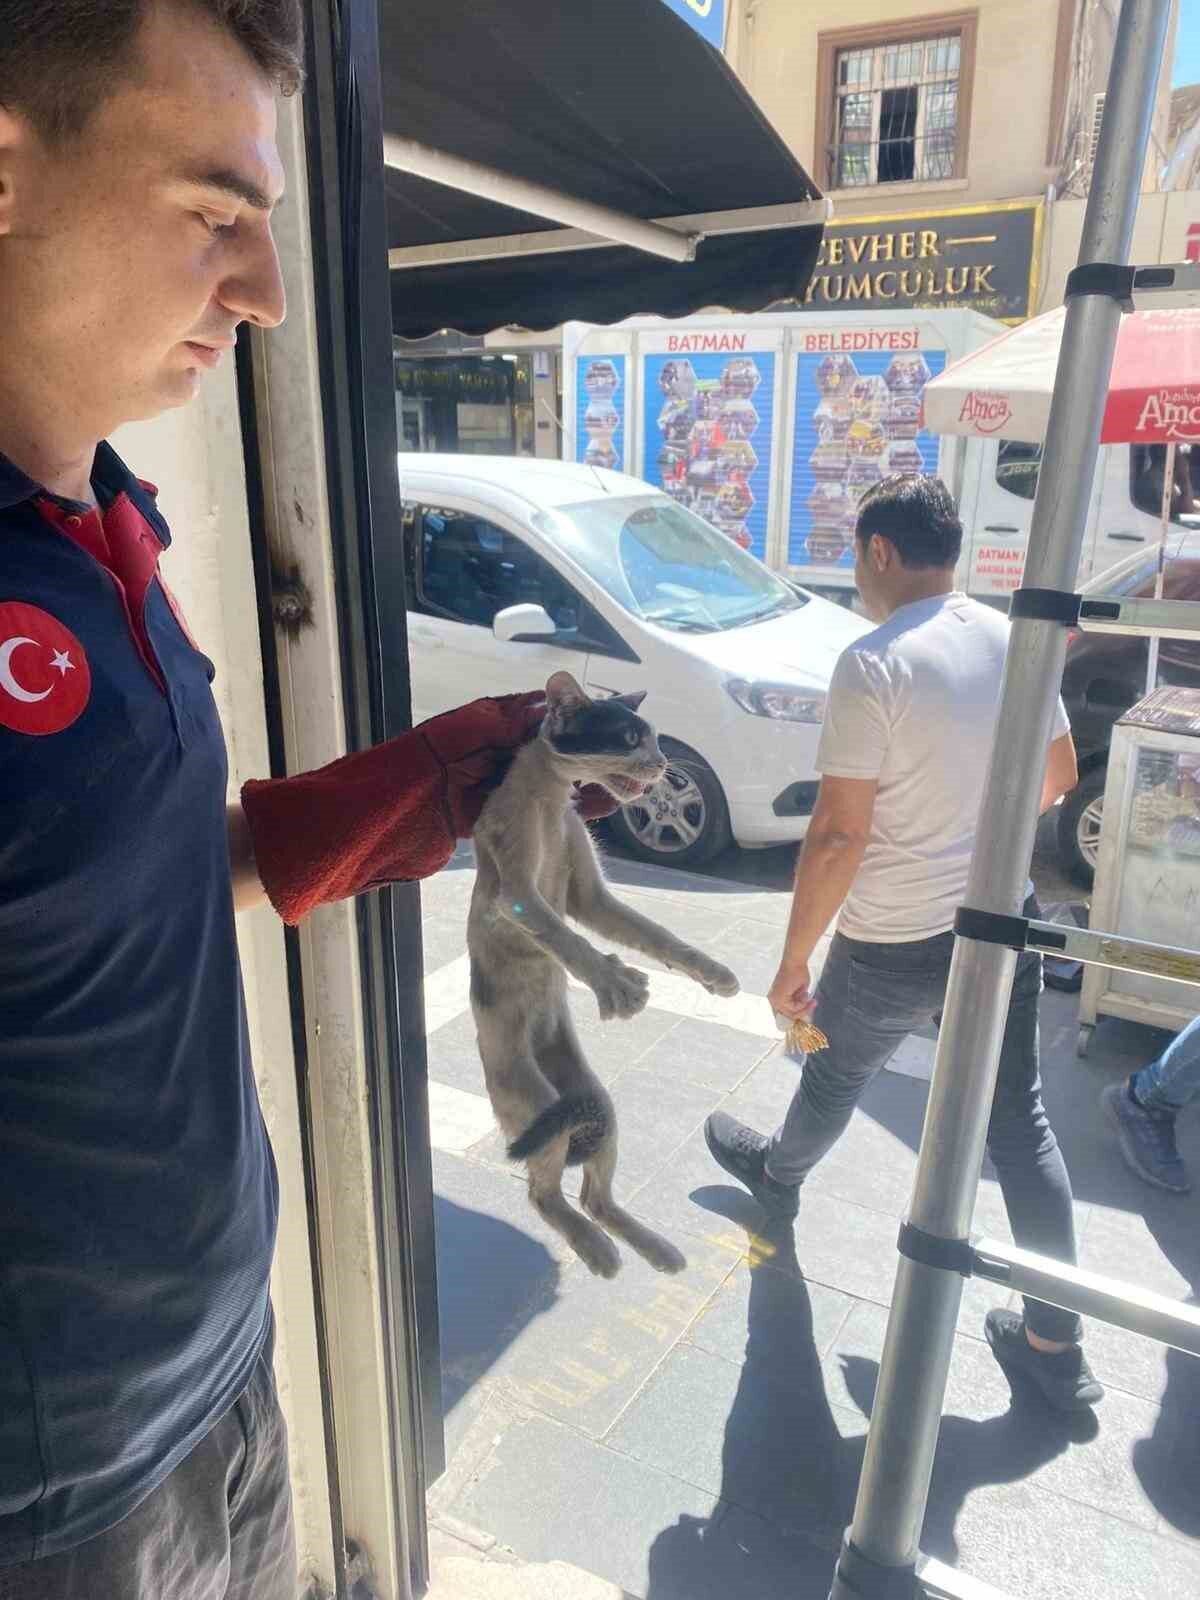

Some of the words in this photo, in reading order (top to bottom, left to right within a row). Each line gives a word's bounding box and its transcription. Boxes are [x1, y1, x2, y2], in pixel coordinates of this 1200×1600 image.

[668, 333, 747, 352] BATMAN
[804, 327, 920, 352] BELEDİYESİ
[957, 391, 1009, 421] Amca
[978, 548, 1018, 561] BATMAN
